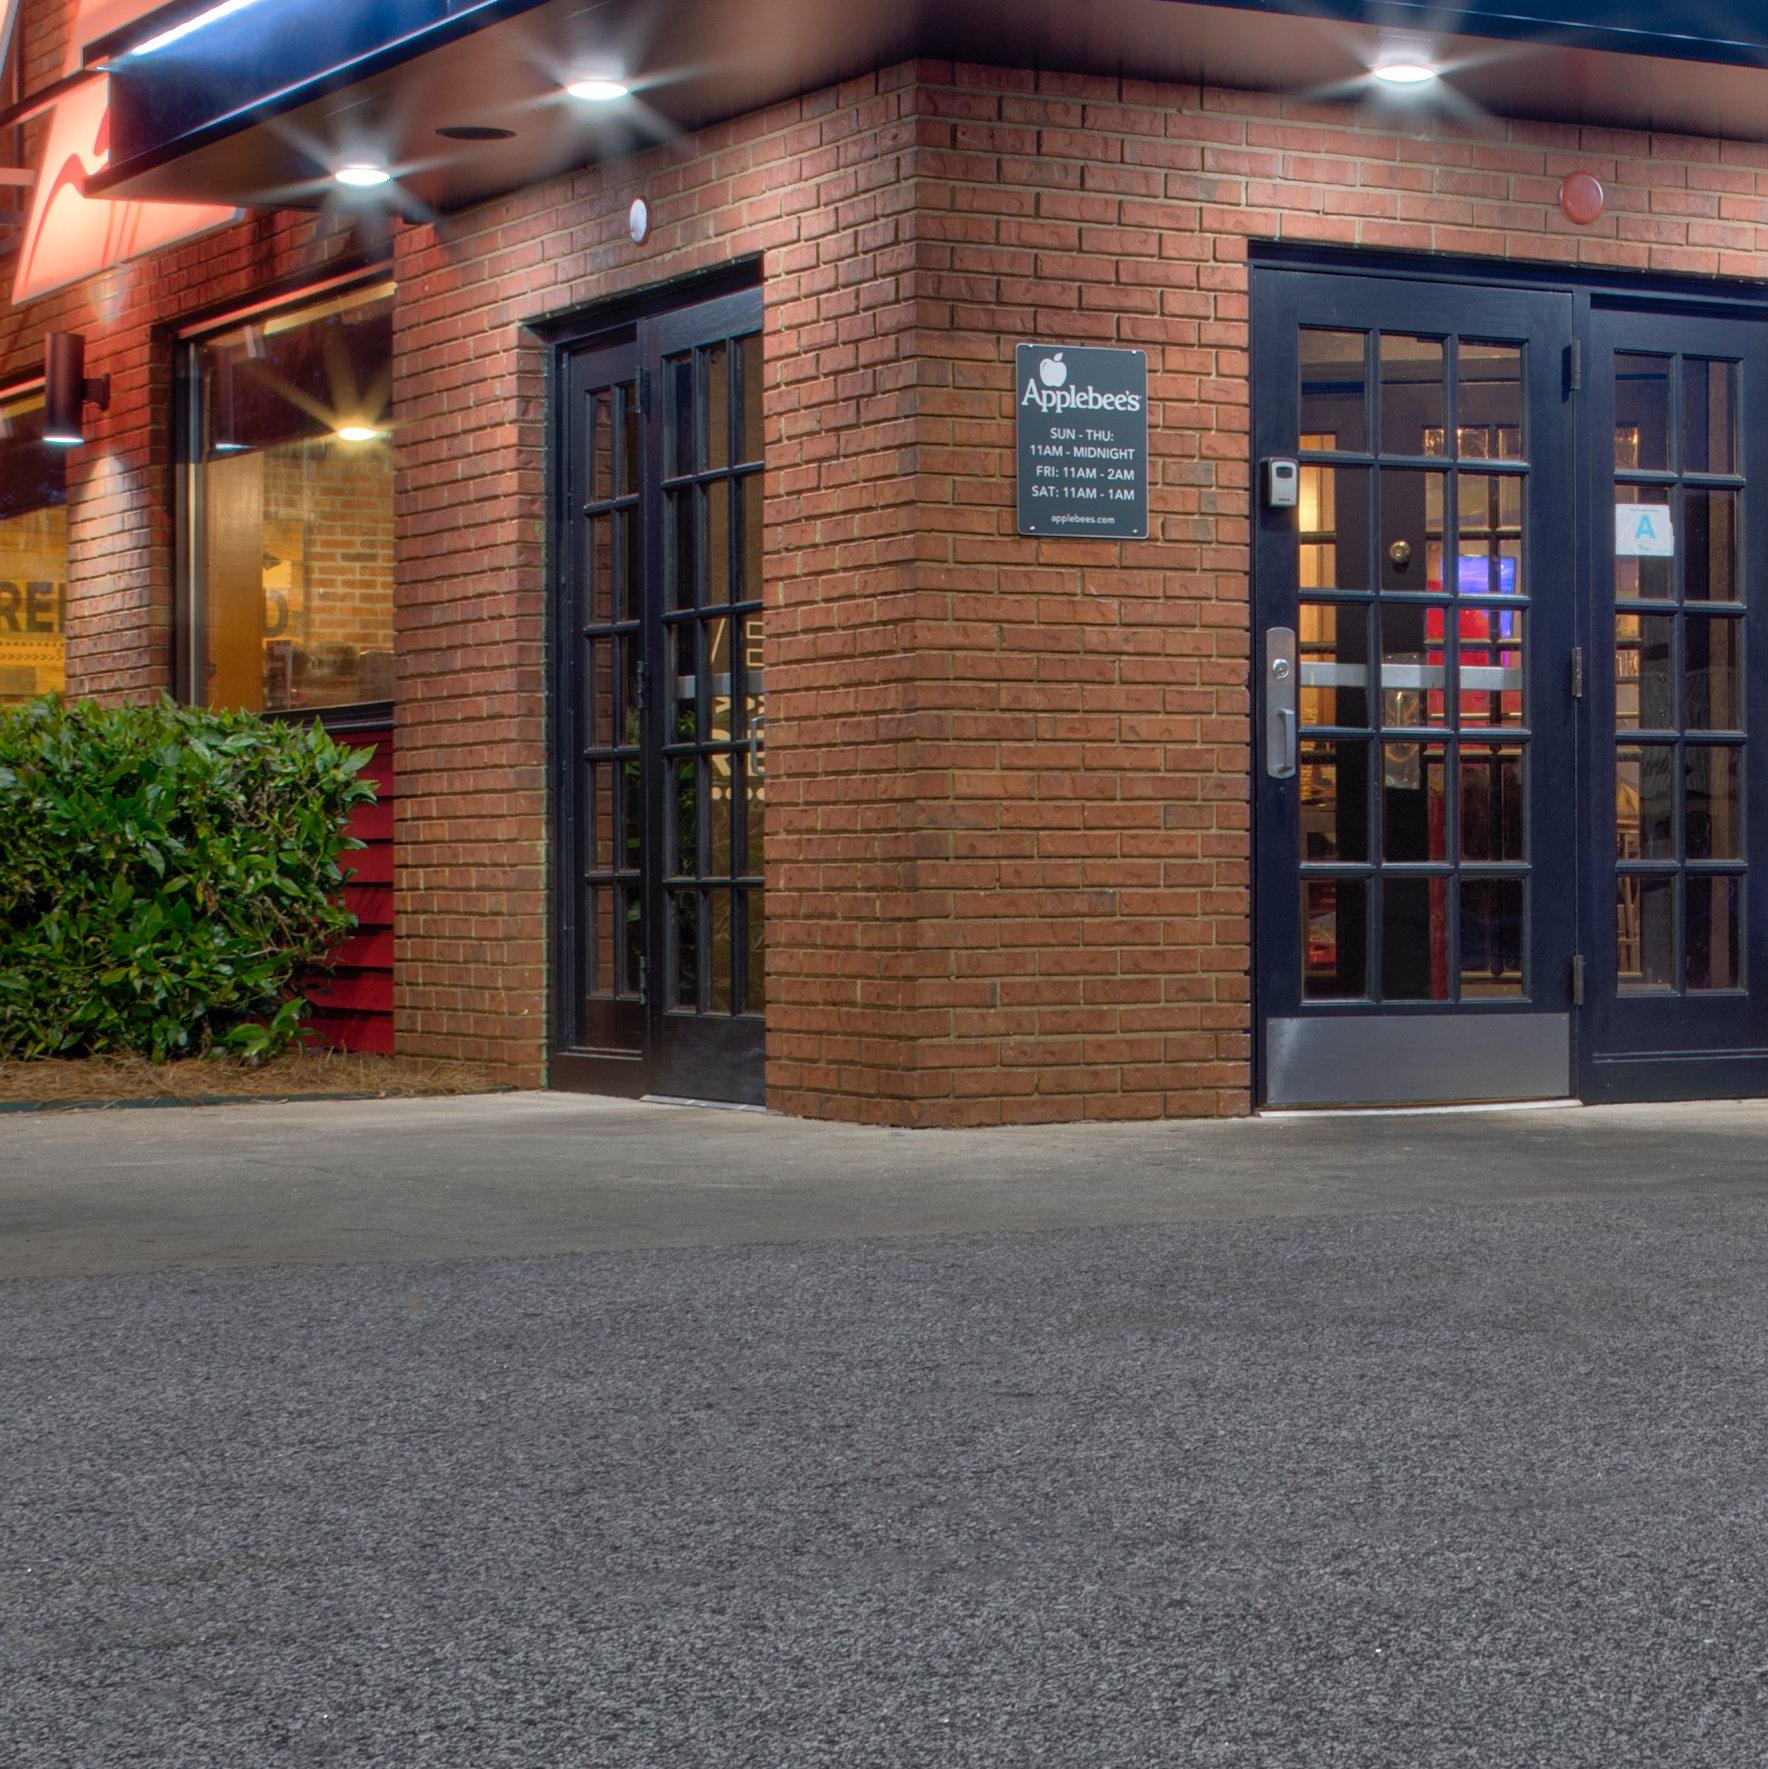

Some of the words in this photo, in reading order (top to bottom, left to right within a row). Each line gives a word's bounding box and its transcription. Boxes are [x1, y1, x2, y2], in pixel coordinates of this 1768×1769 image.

[1021, 378, 1141, 413] Applebee's
[1050, 427, 1075, 440] SUN
[1086, 429, 1114, 441] THU:
[1030, 444, 1063, 457] 11AM
[1074, 447, 1135, 460] MIDNIGHT
[1036, 465, 1059, 478] FRI:
[1063, 467, 1097, 479] 11AM
[1107, 468, 1135, 480] 2AM
[1031, 485, 1059, 498] SAT:
[1063, 486, 1097, 499] 11AM
[1109, 488, 1135, 501] 1AM
[1051, 513, 1115, 525] applebees.com
[1635, 515, 1656, 539] A
